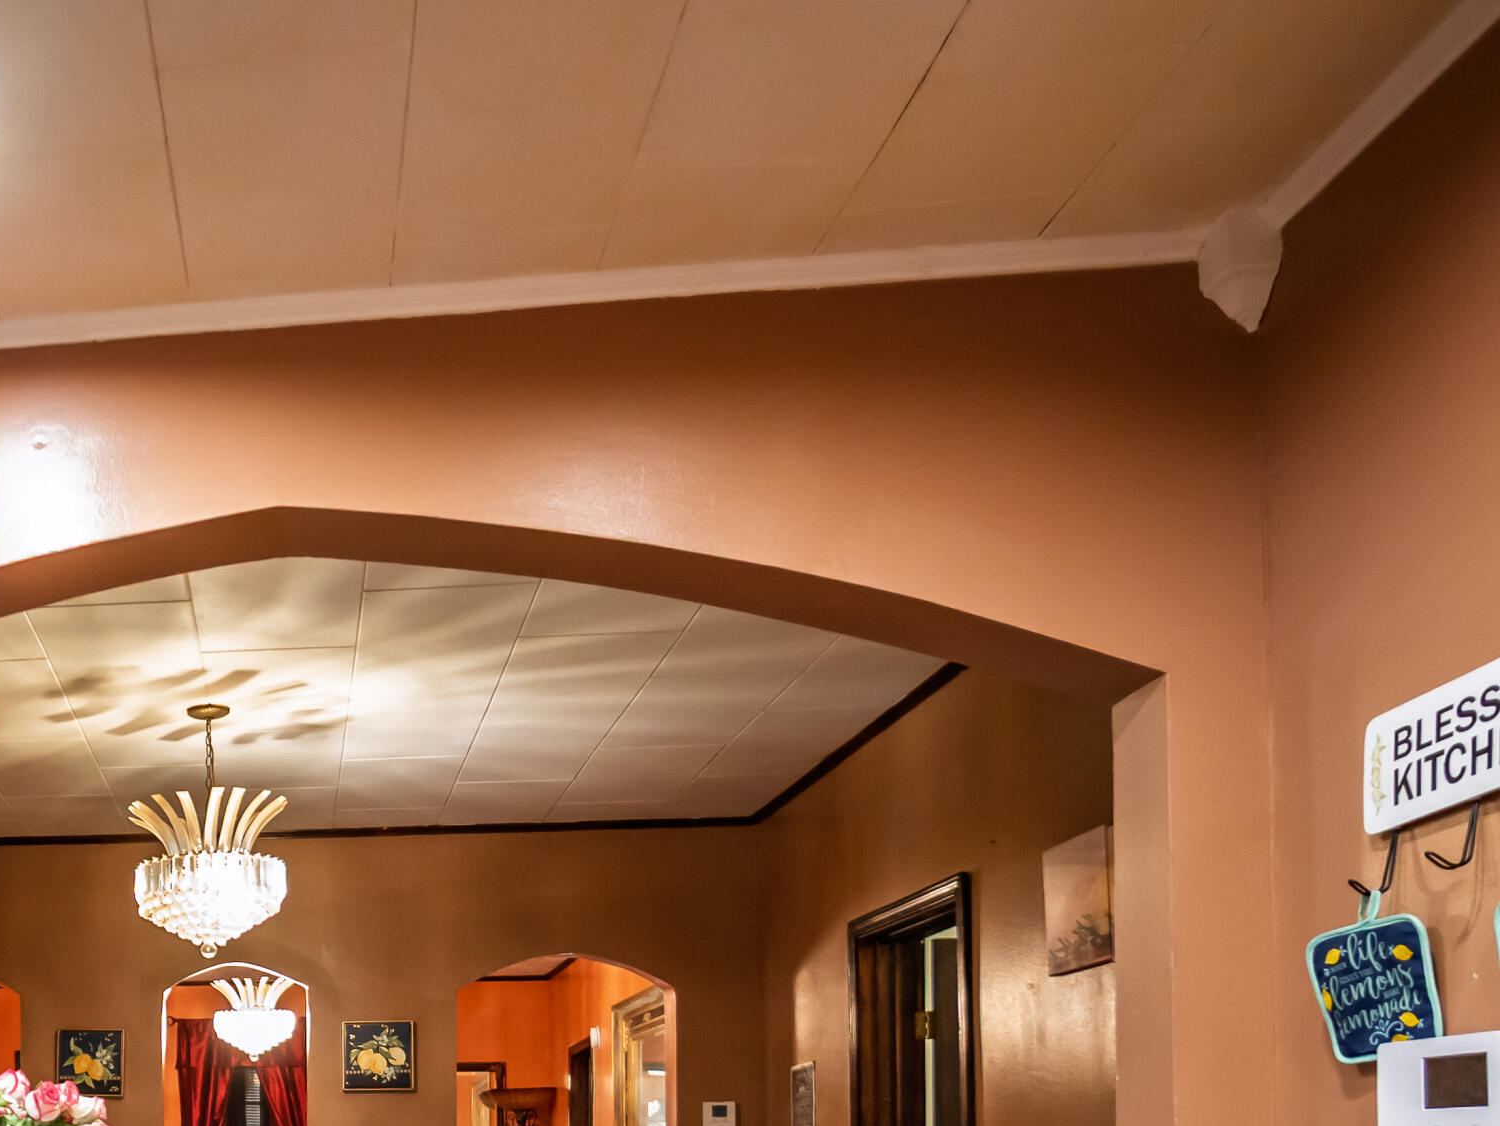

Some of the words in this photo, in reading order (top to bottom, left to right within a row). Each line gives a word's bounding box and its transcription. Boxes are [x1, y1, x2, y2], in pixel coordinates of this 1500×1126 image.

[1393, 684, 1500, 762] BLESS
[1393, 728, 1500, 807] KITCH
[1346, 931, 1388, 972] life
[1329, 963, 1415, 1011] lemons
